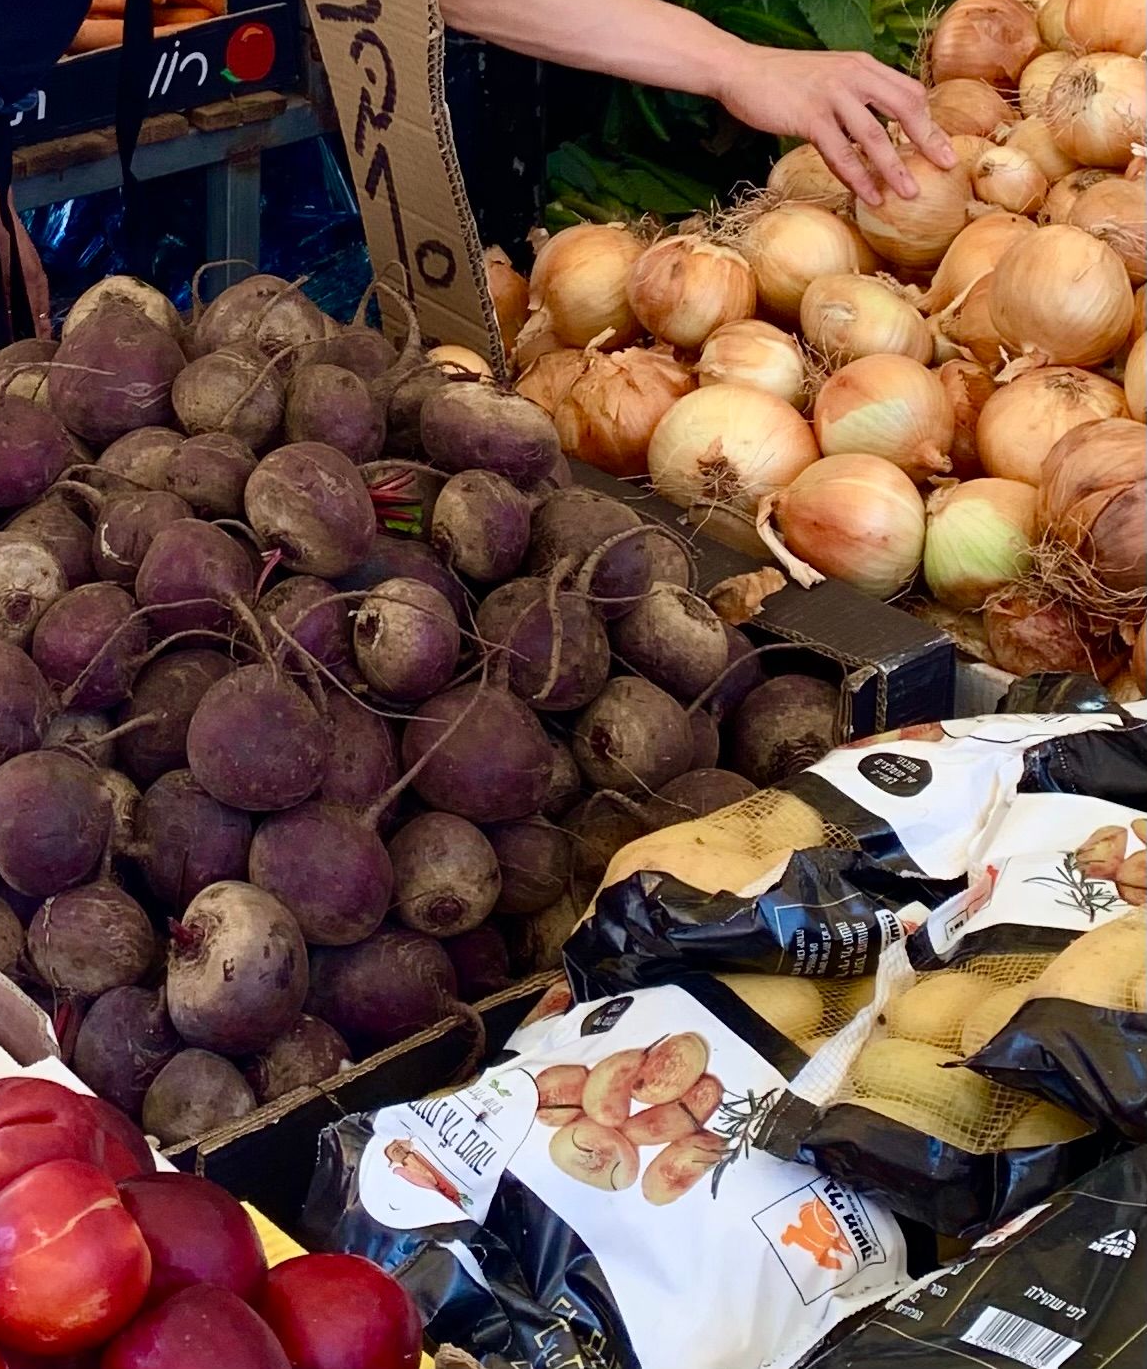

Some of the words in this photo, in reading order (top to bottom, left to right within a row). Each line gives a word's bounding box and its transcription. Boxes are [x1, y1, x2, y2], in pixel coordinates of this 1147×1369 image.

[455, 1129, 497, 1176] משה
[843, 1213, 873, 1261] משה
[1024, 1284, 1066, 1311] שקילה
[1066, 1305, 1088, 1321] לפי
